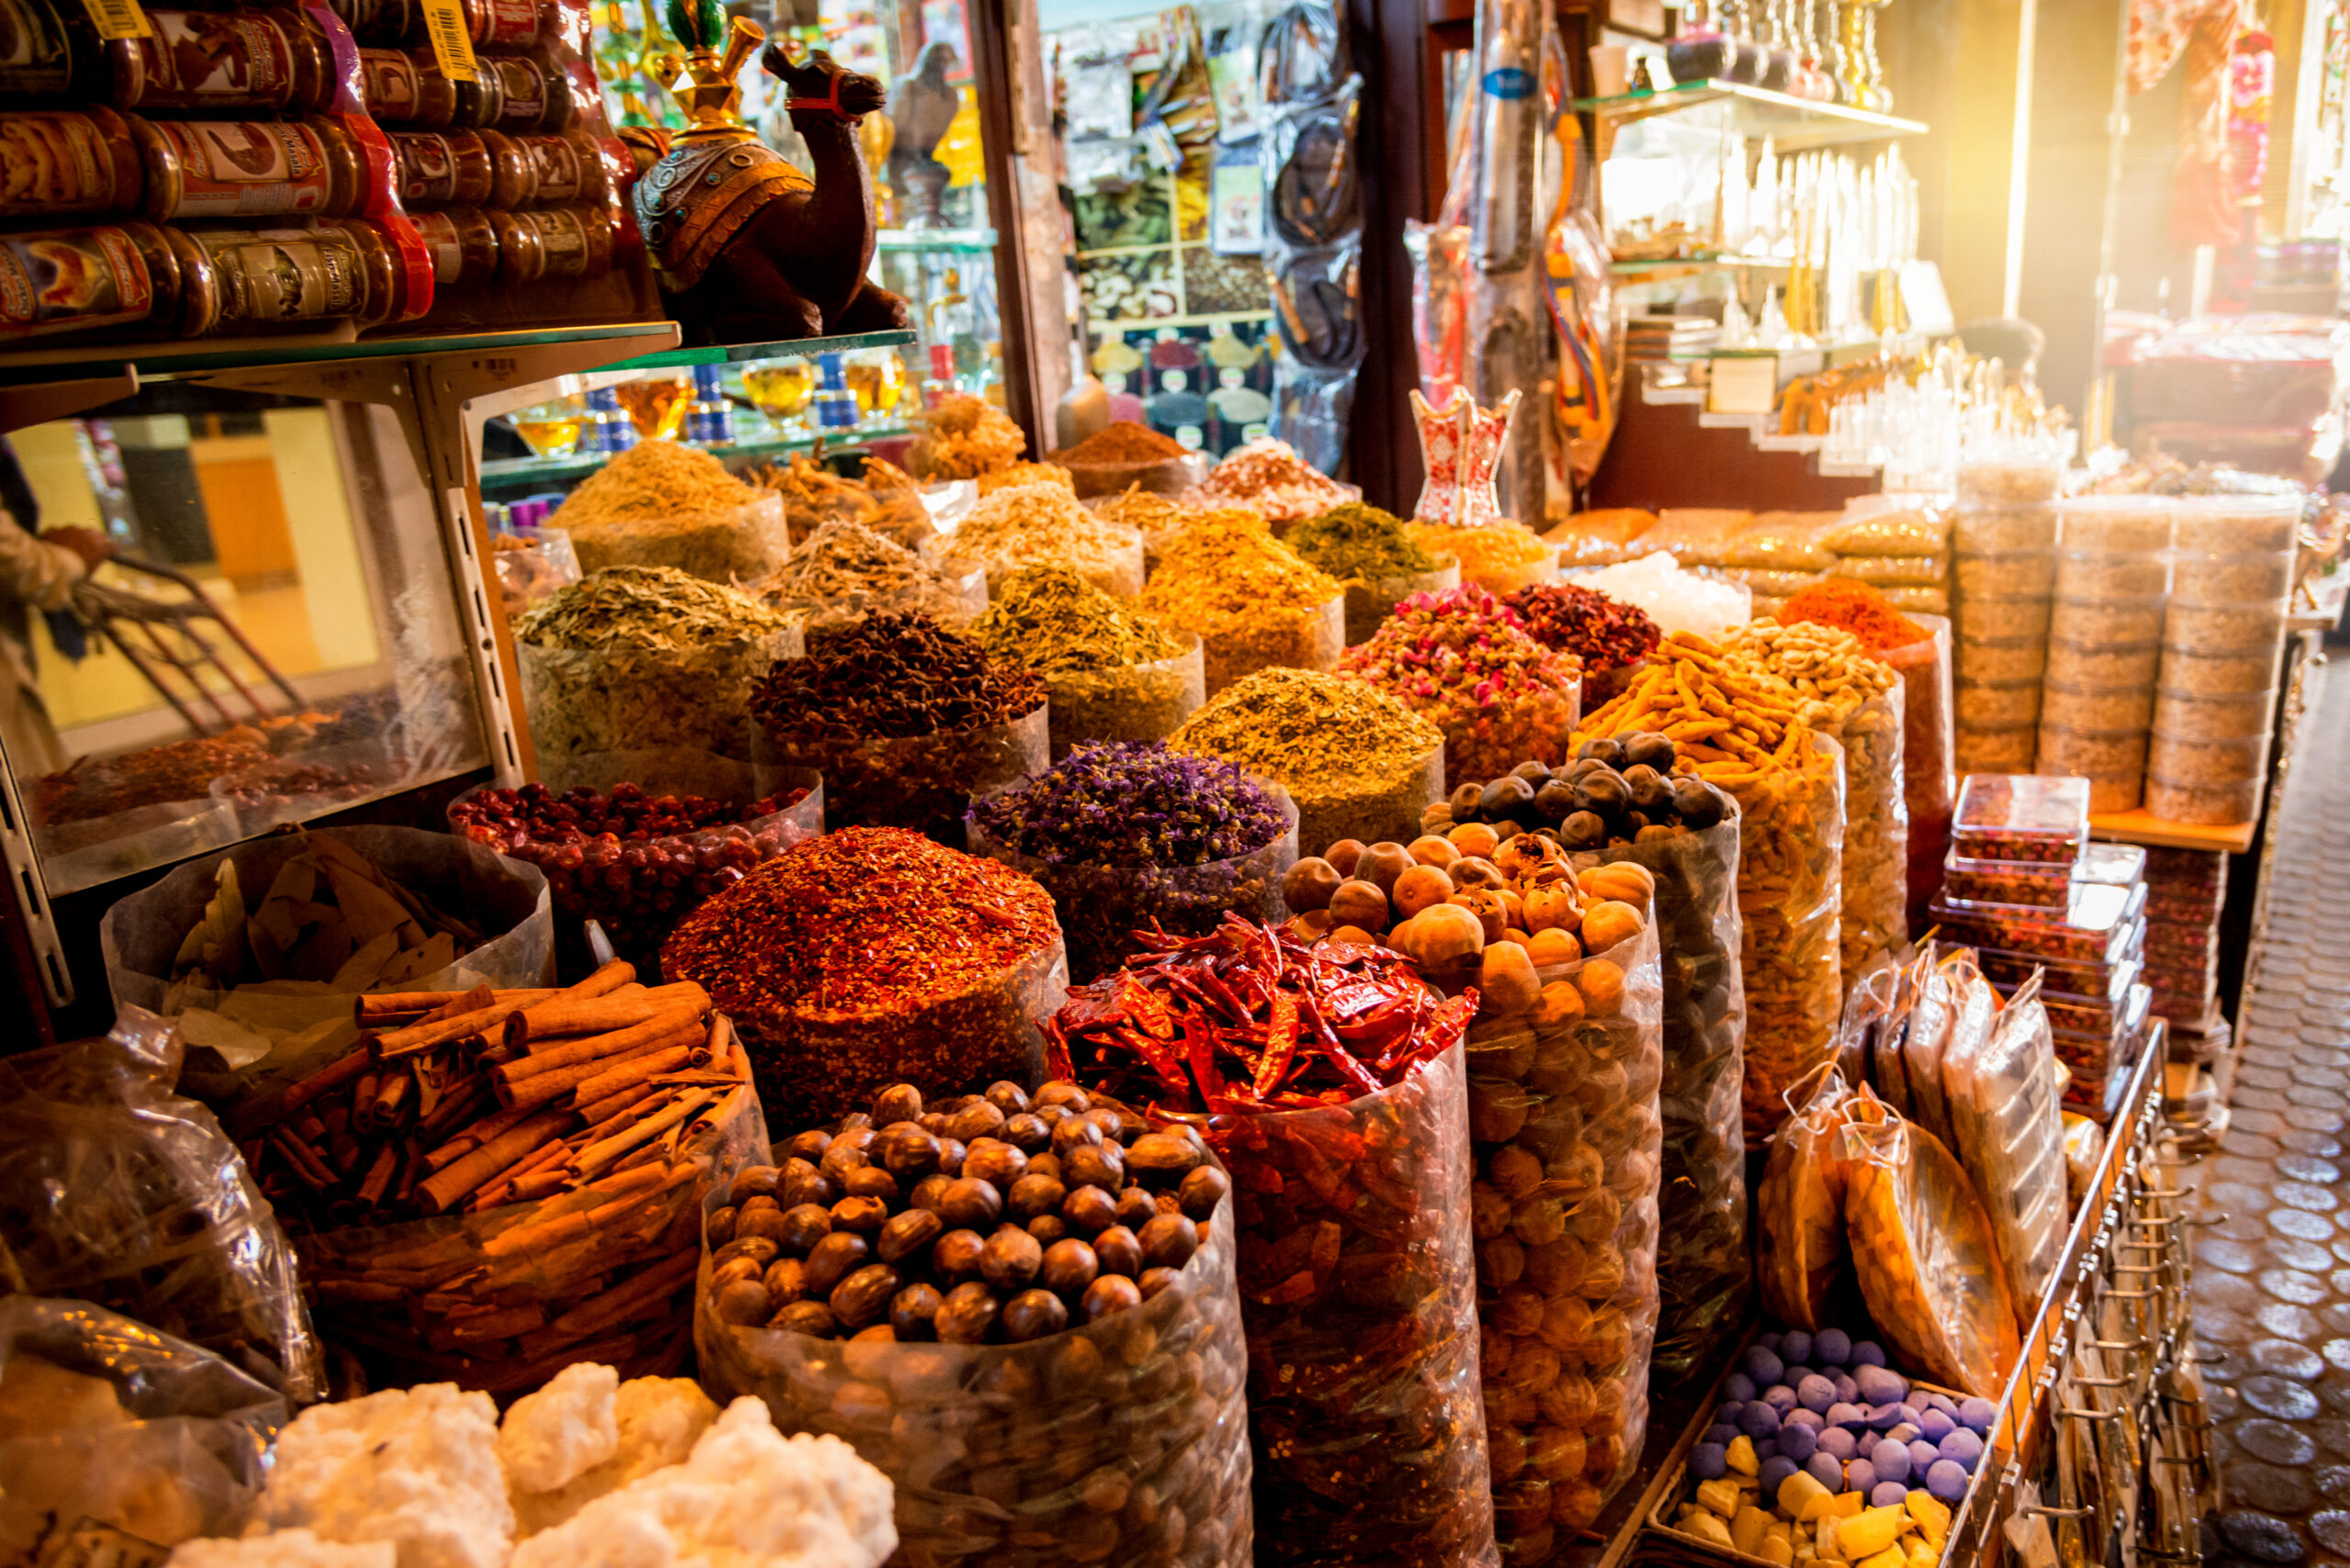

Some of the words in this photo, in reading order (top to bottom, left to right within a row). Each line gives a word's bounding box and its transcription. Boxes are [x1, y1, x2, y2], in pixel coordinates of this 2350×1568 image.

[284, 140, 301, 174] Masala
[323, 249, 336, 270] Fish
[330, 272, 341, 308] Masala
